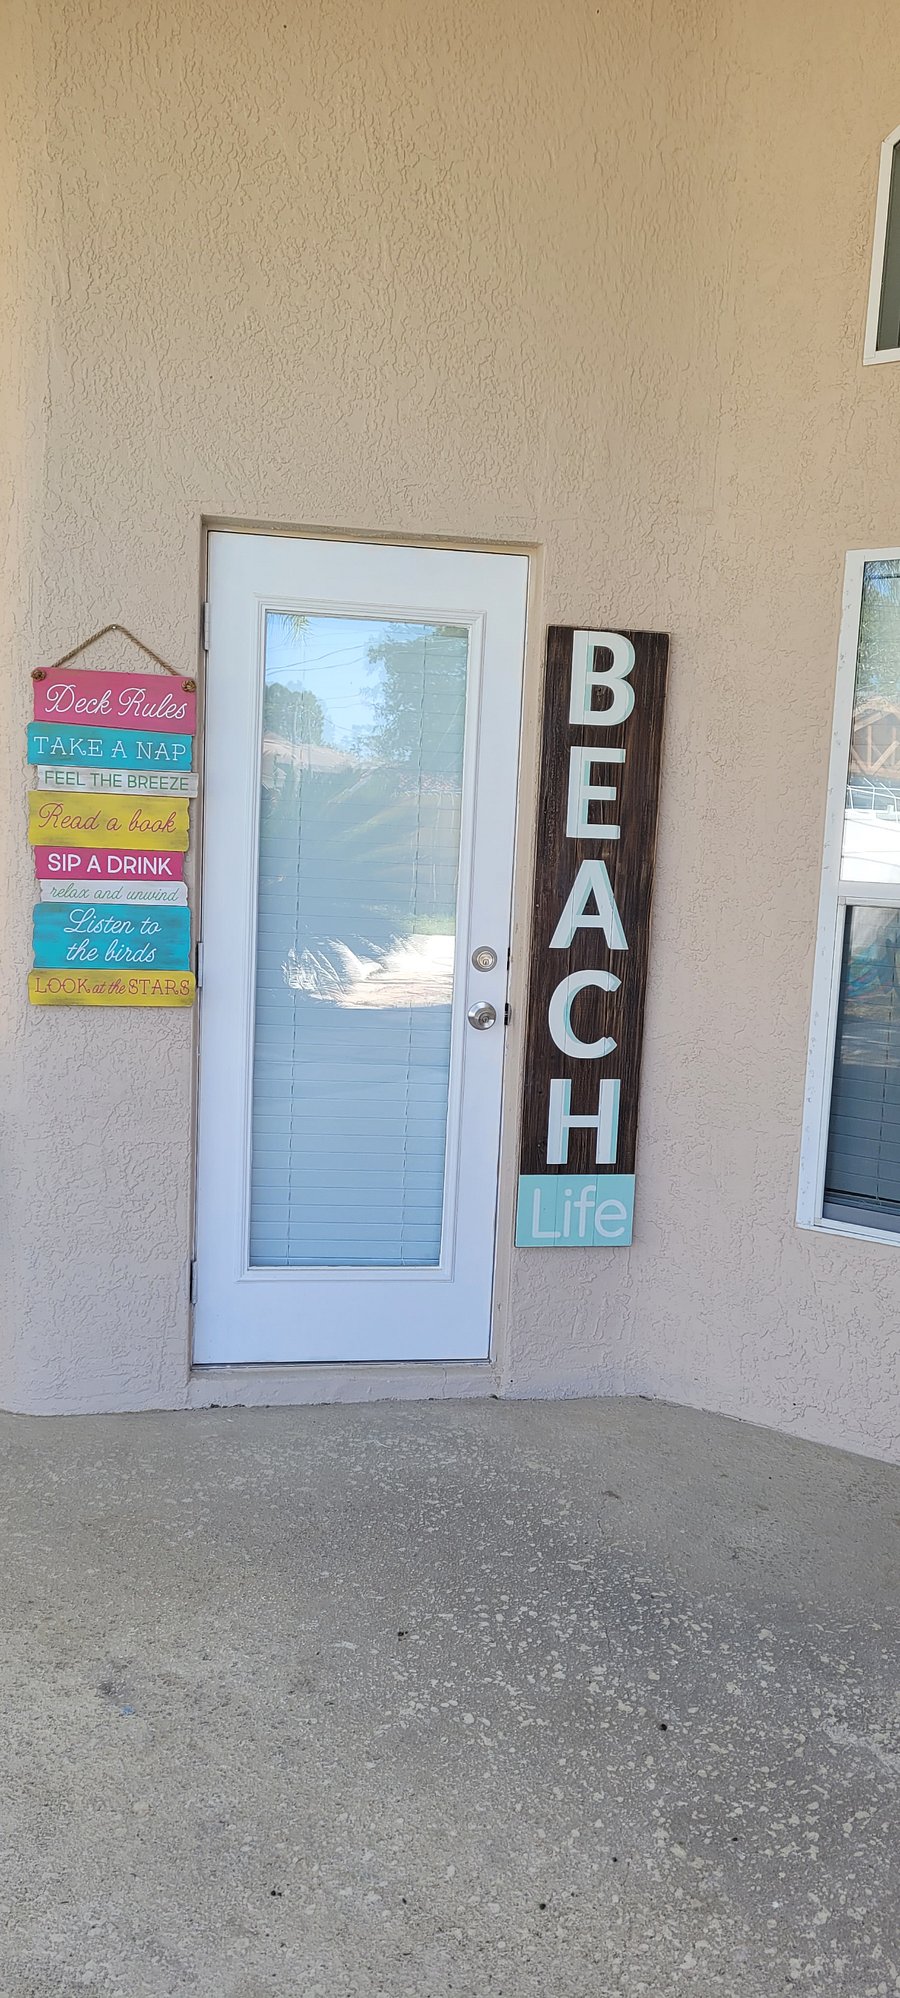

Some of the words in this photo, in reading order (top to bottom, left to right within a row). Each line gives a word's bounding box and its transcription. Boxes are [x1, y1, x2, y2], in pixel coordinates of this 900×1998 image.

[45, 684, 112, 715] Deck
[117, 687, 188, 719] Rules
[34, 736, 103, 757] TAKE
[111, 740, 127, 759] A
[136, 741, 186, 761] NAP
[44, 770, 86, 786] FEEL
[90, 772, 122, 788] THE
[127, 774, 189, 791] BREEZE
[38, 802, 102, 830] Read
[106, 818, 123, 831] a
[128, 808, 177, 835] book
[47, 853, 81, 872] SIP
[86, 855, 101, 873] A
[107, 855, 172, 875] DRINK
[50, 882, 91, 899] relax
[93, 885, 124, 900] and
[126, 887, 179, 902] unwind
[546, 629, 637, 1166] BEACH
[63, 907, 135, 934] Listen
[139, 916, 162, 935] to
[66, 938, 99, 962] the
[104, 939, 157, 963] birds
[34, 977, 91, 994] LOOK
[91, 980, 106, 994] at
[107, 979, 127, 995] the
[128, 978, 191, 996] STARS
[530, 1184, 628, 1240] Life
